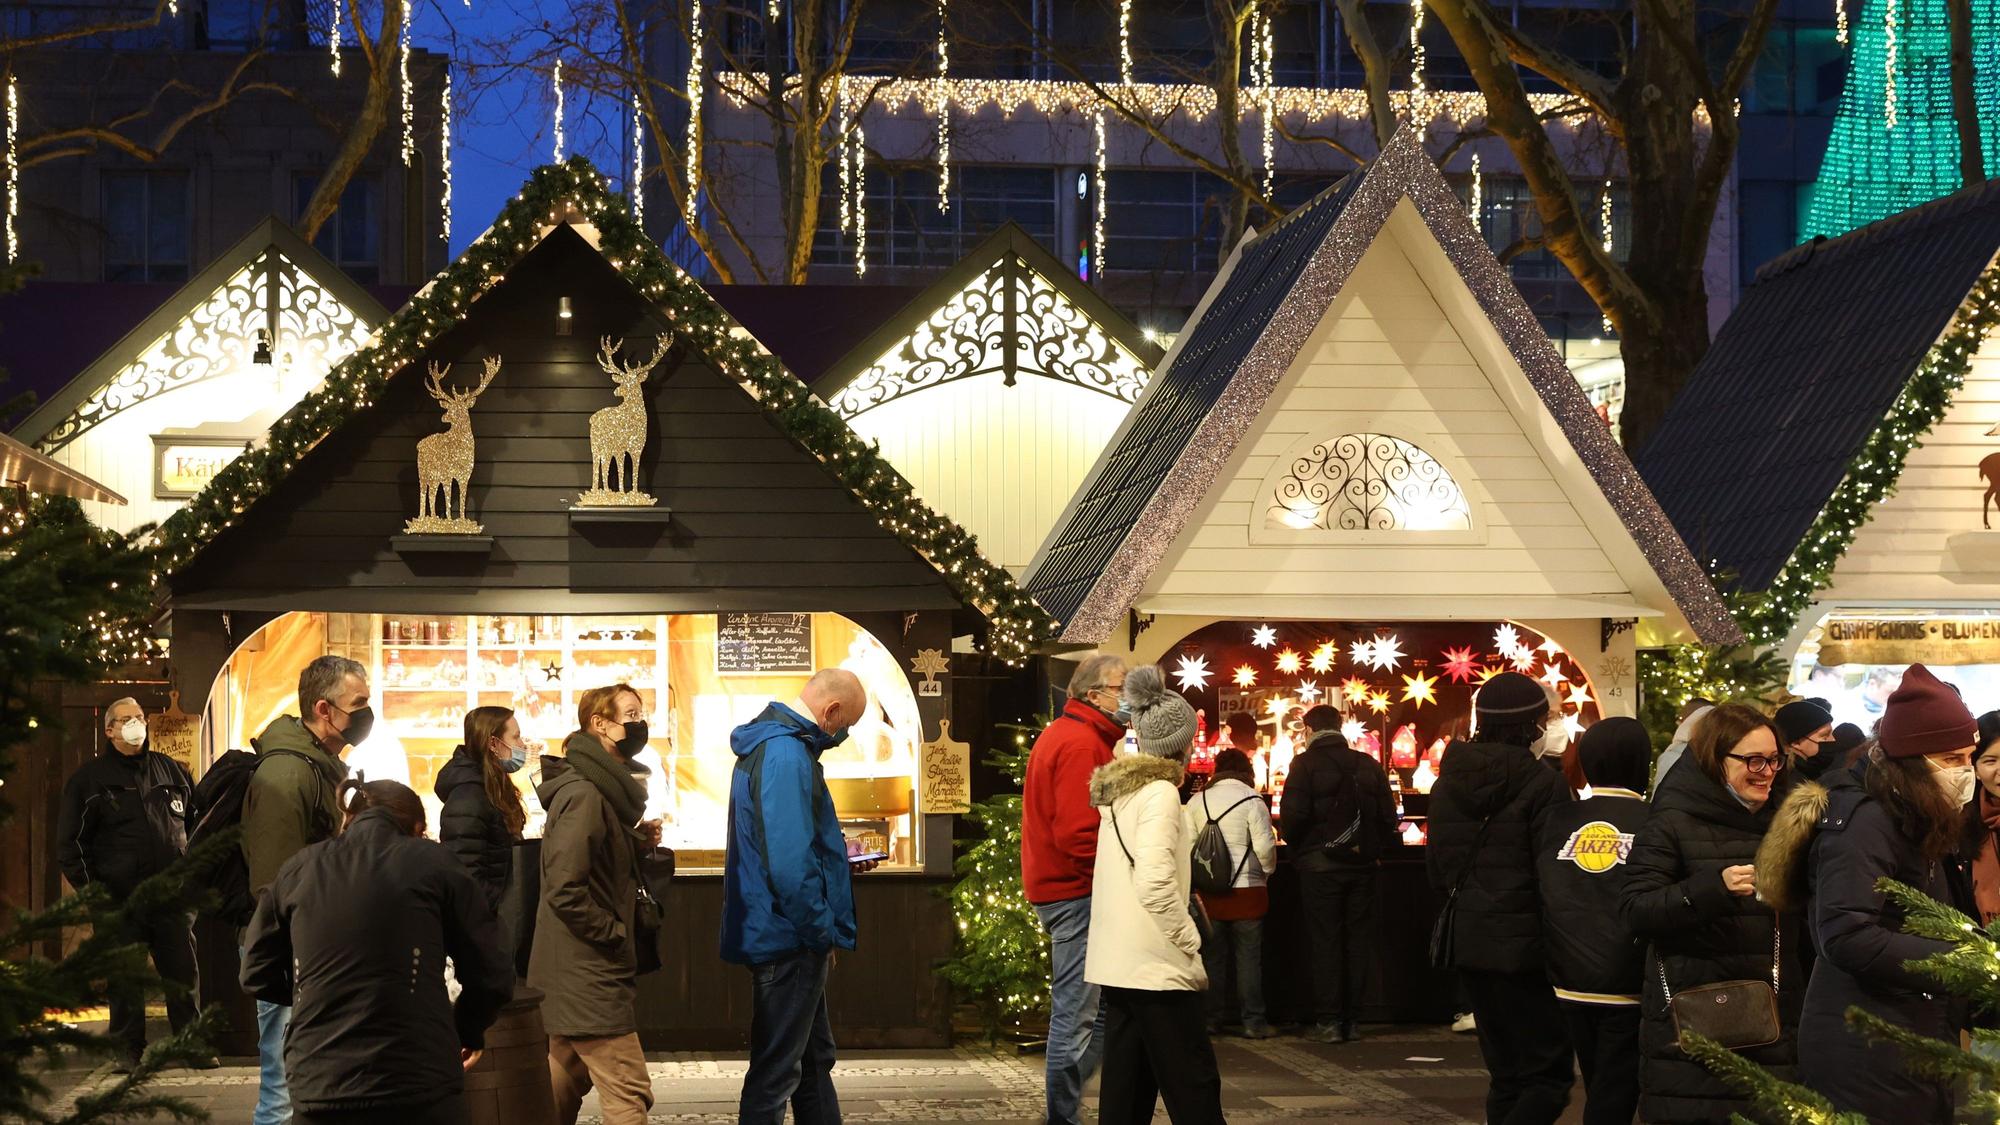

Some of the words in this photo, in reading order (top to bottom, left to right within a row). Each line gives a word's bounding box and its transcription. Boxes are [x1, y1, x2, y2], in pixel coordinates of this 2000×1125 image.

[1829, 622, 1926, 640] CHAMPIGNONS
[922, 684, 938, 694] 44
[1608, 687, 1622, 697] 43
[1562, 834, 1633, 860] LAKERS
